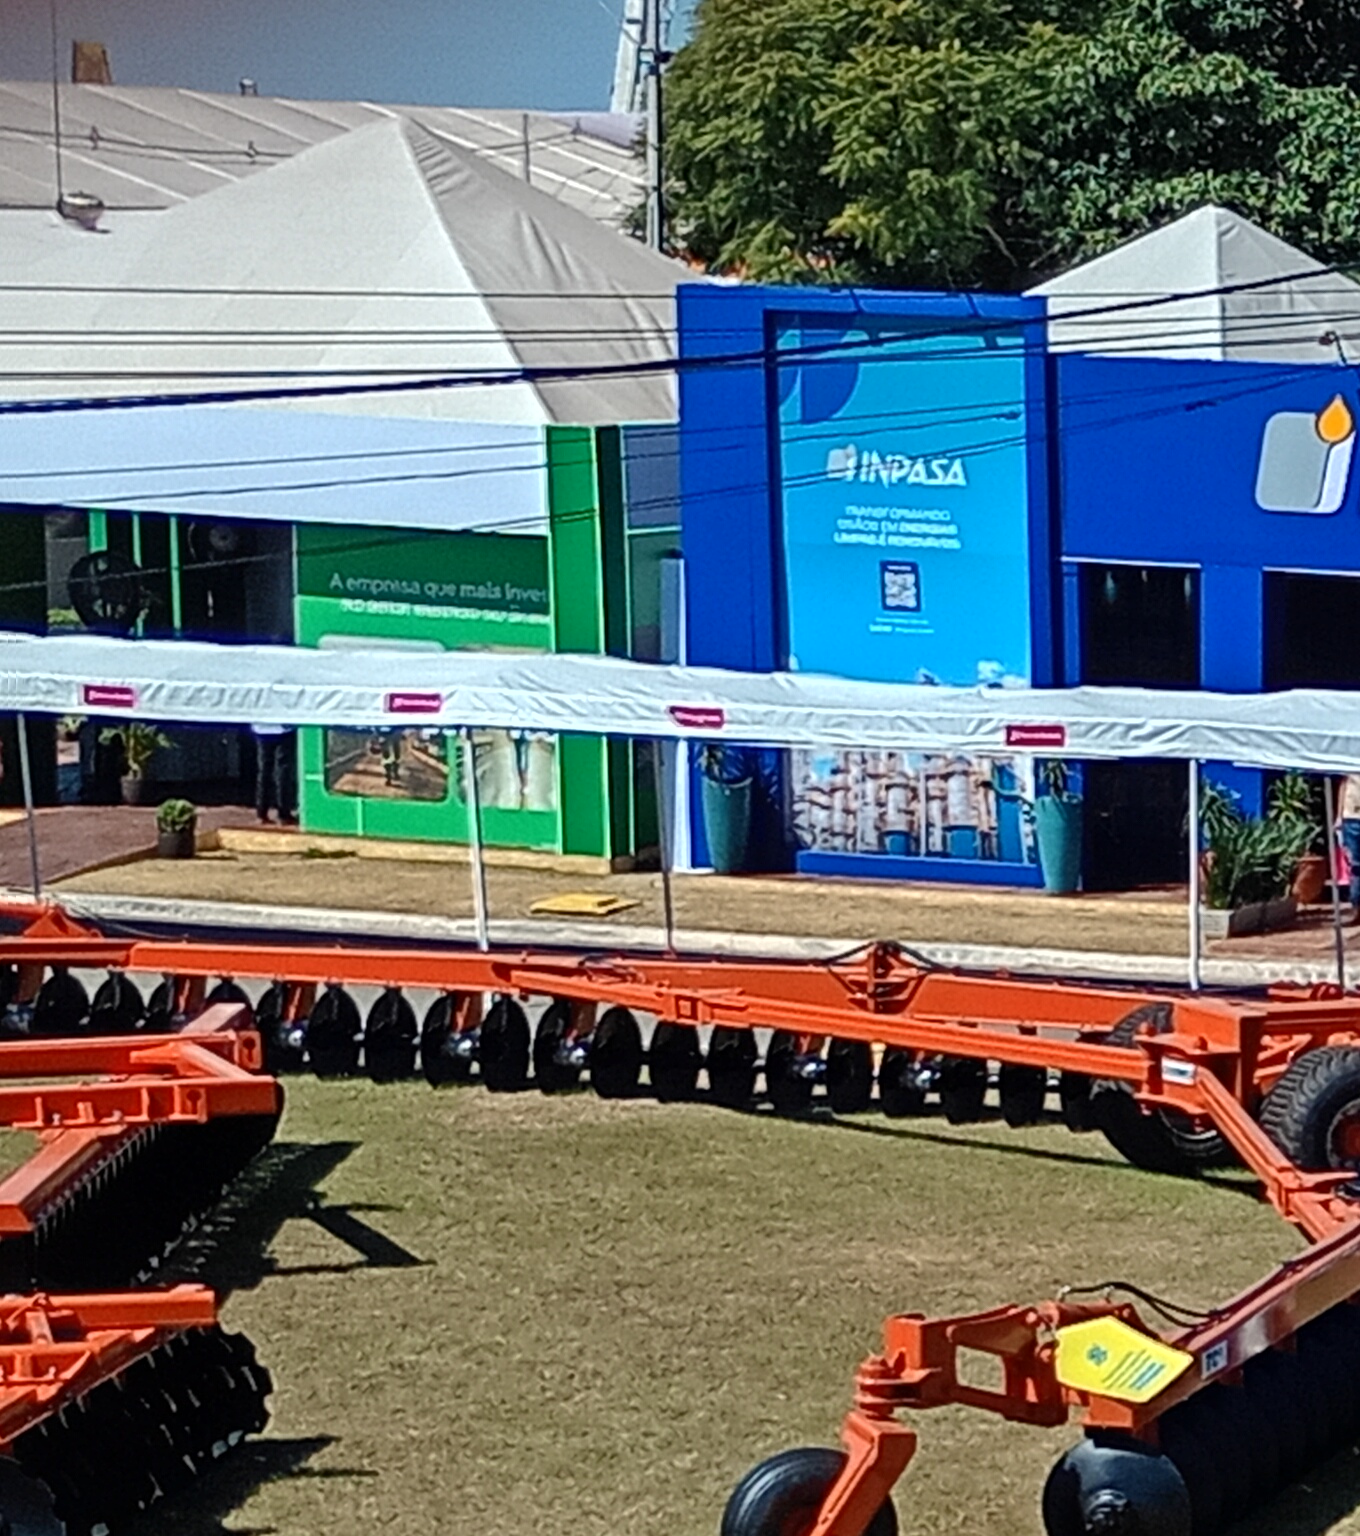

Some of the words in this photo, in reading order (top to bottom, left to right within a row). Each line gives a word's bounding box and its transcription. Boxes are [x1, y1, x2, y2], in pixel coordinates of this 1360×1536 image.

[859, 449, 967, 489] INPASA
[329, 573, 344, 590] A
[424, 580, 458, 598] que
[459, 581, 502, 599] mais
